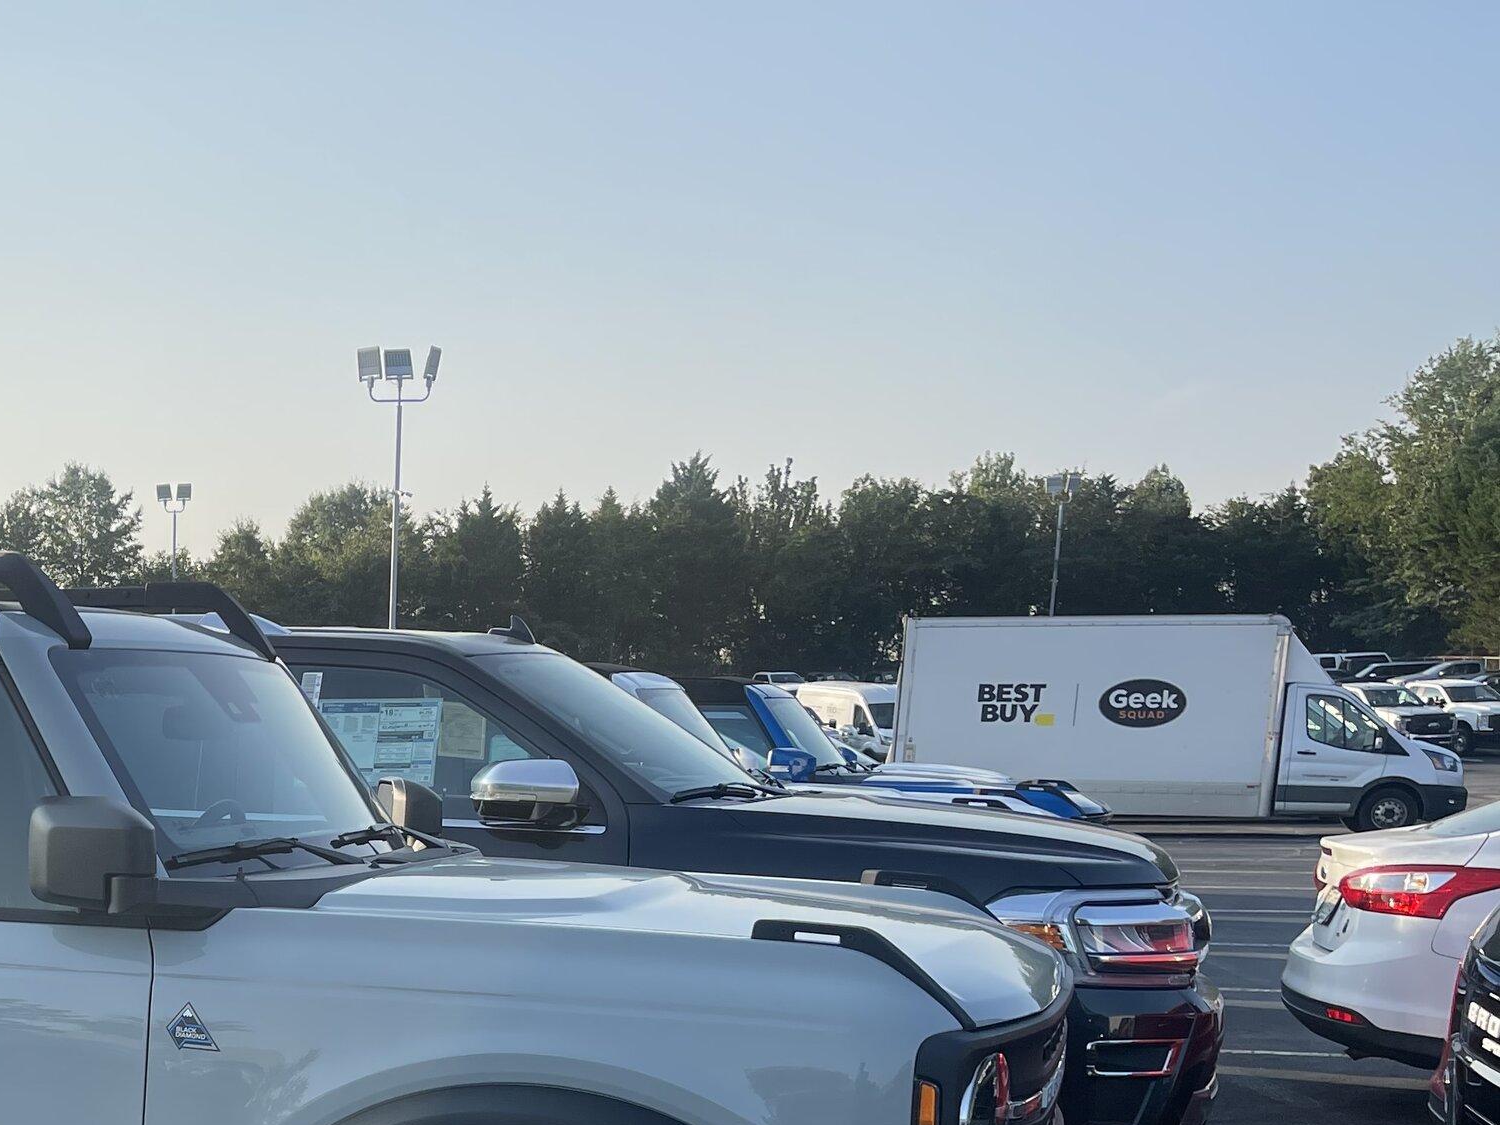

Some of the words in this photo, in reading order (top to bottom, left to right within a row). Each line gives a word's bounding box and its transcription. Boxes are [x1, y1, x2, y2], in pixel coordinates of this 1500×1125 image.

[978, 684, 1047, 702] BEST
[1109, 689, 1178, 708] Geek
[981, 704, 1039, 722] BUY
[1119, 710, 1165, 720] SQUAD
